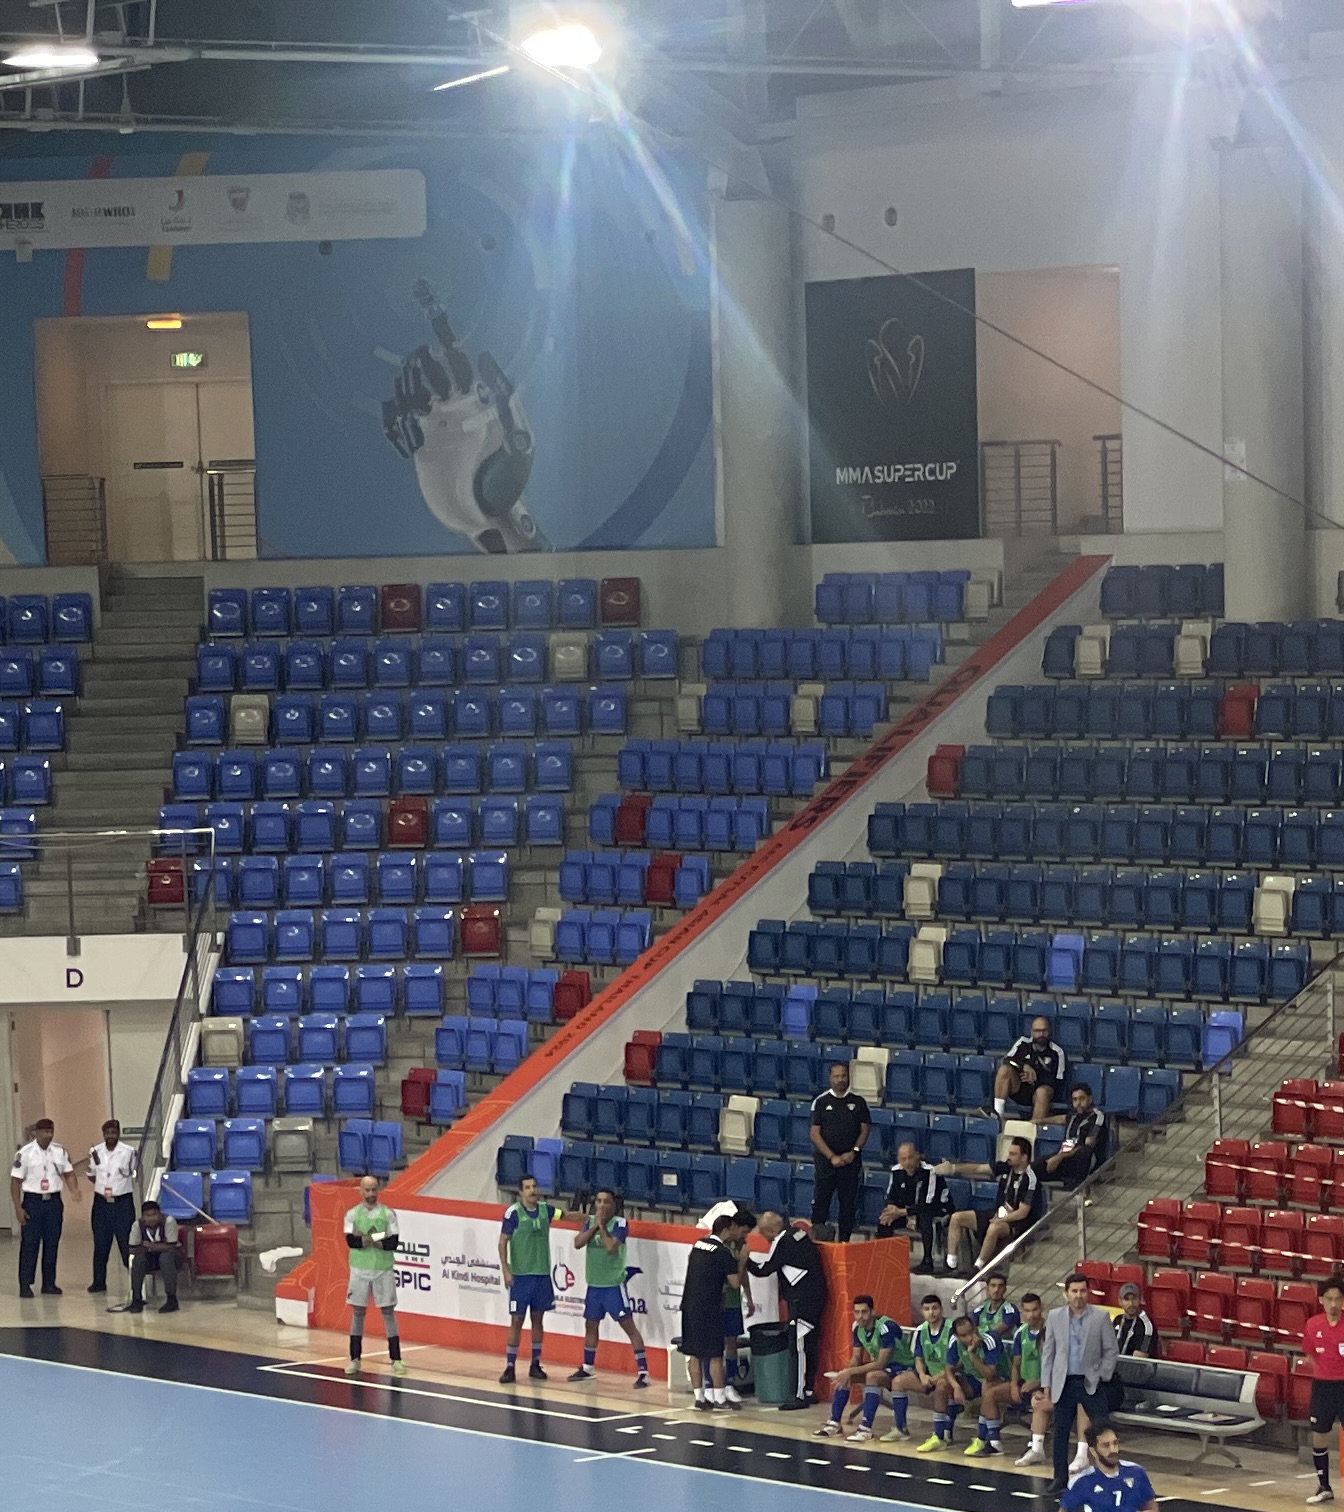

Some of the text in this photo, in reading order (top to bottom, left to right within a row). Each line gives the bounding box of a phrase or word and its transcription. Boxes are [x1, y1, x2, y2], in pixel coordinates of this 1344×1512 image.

[65, 968, 84, 988] D
[470, 1271, 501, 1286] Hospital
[1113, 1490, 1122, 1507] 7
